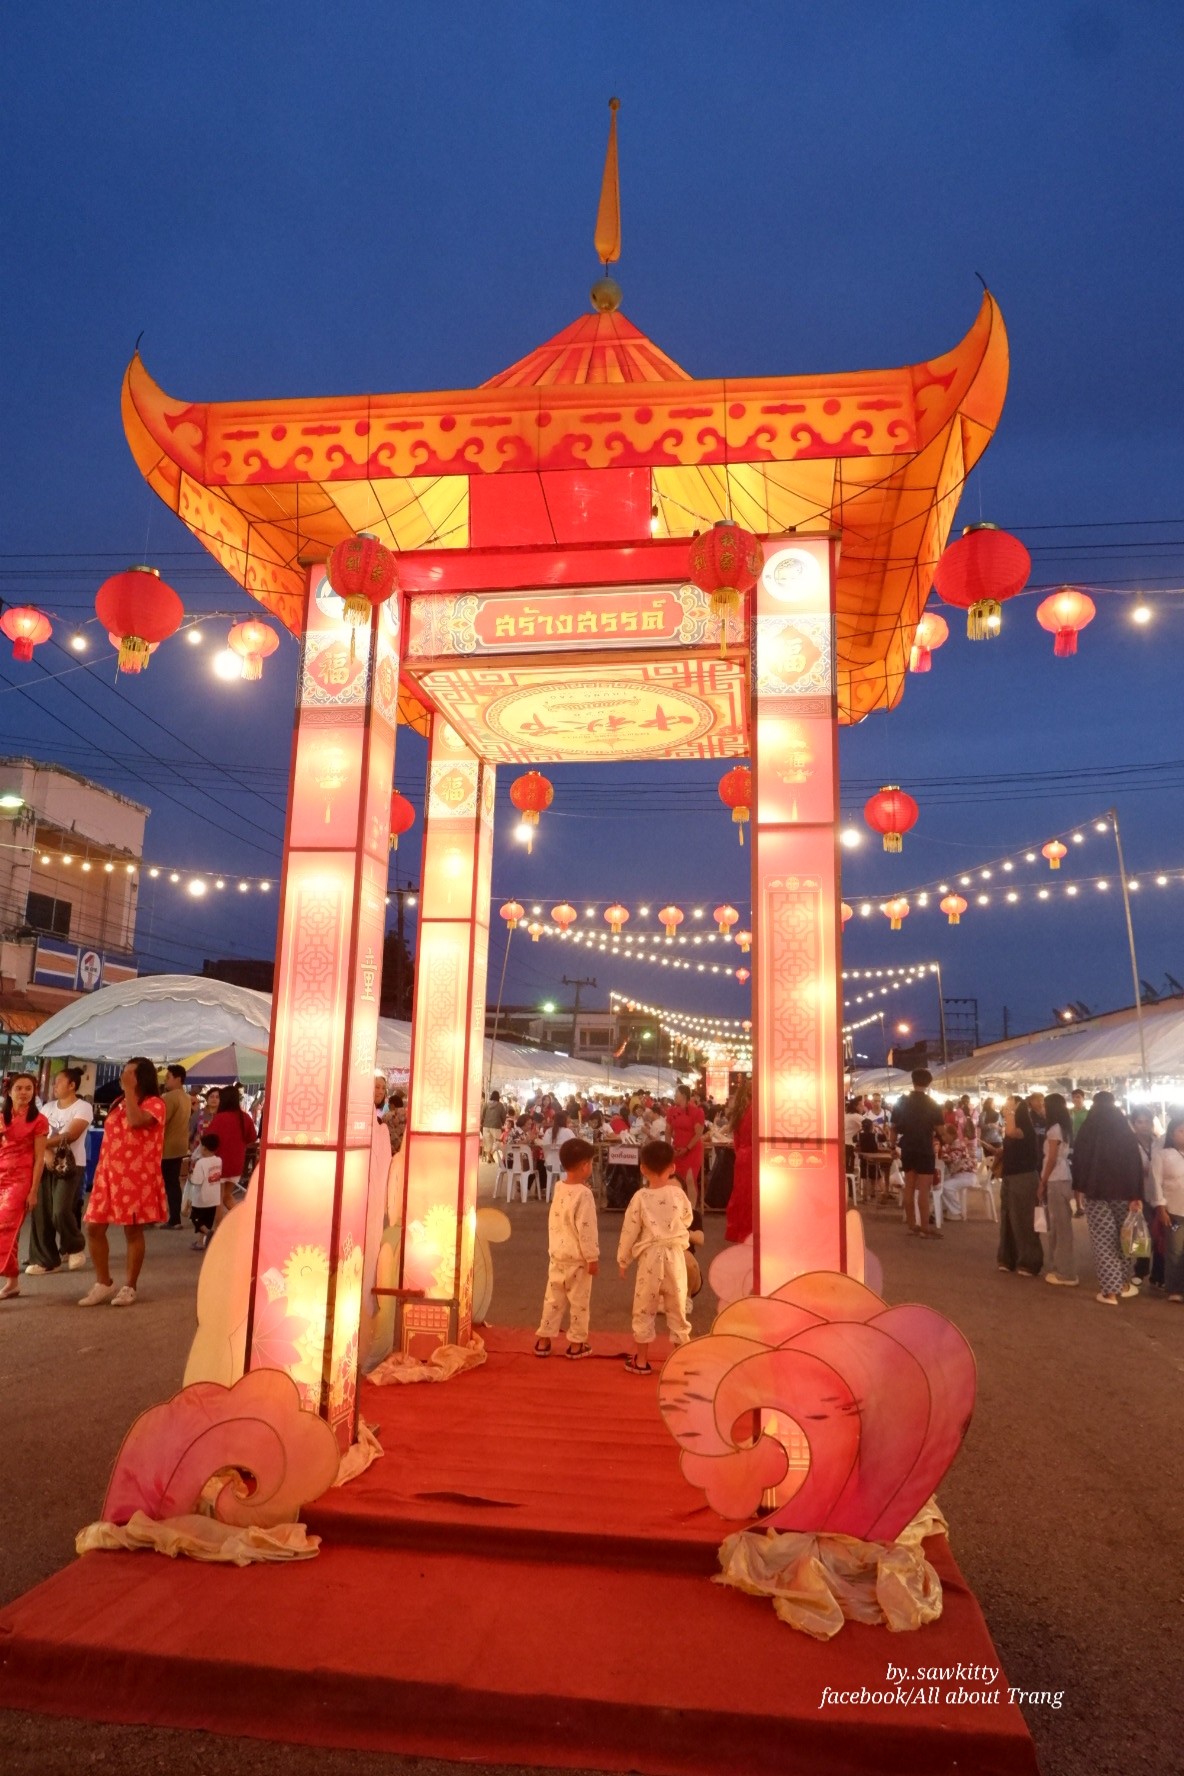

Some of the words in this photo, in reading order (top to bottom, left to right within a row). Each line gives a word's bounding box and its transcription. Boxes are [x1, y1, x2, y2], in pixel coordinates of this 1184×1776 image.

[495, 599, 667, 637] สร้างสรรค์
[317, 652, 350, 685] 福
[516, 703, 695, 737] 中秋节
[440, 776, 465, 801] 福
